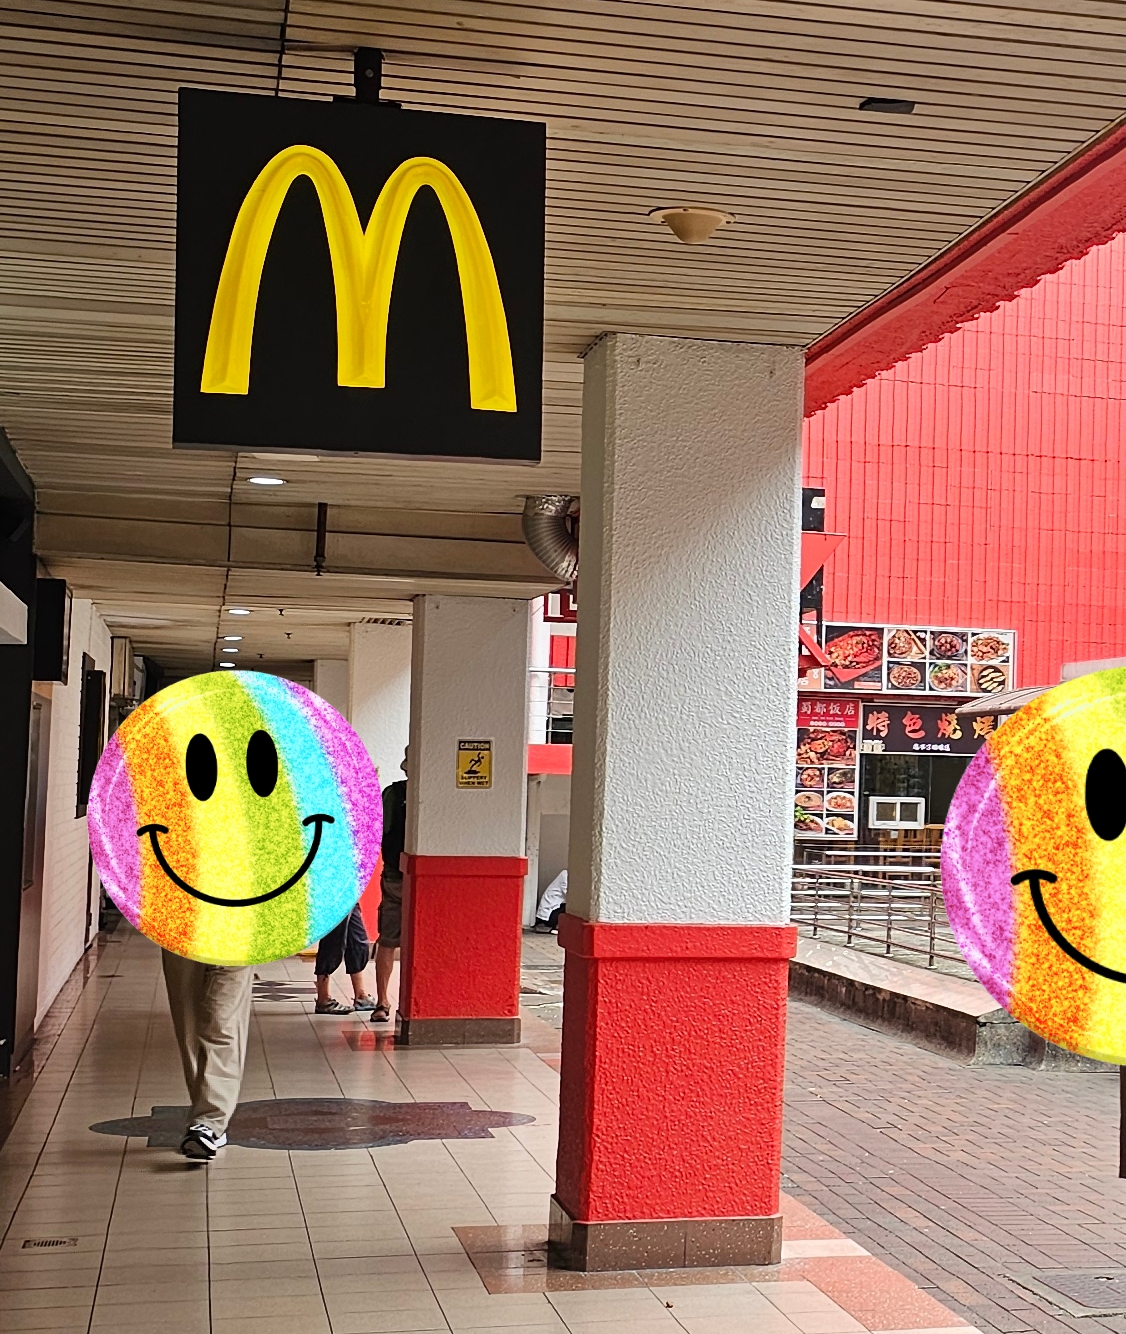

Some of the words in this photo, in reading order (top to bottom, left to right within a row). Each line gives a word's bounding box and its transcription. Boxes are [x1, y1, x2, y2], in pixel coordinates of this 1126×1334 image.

[800, 701, 856, 715] 蜀都饭店
[865, 711, 995, 740] 特色烧烤
